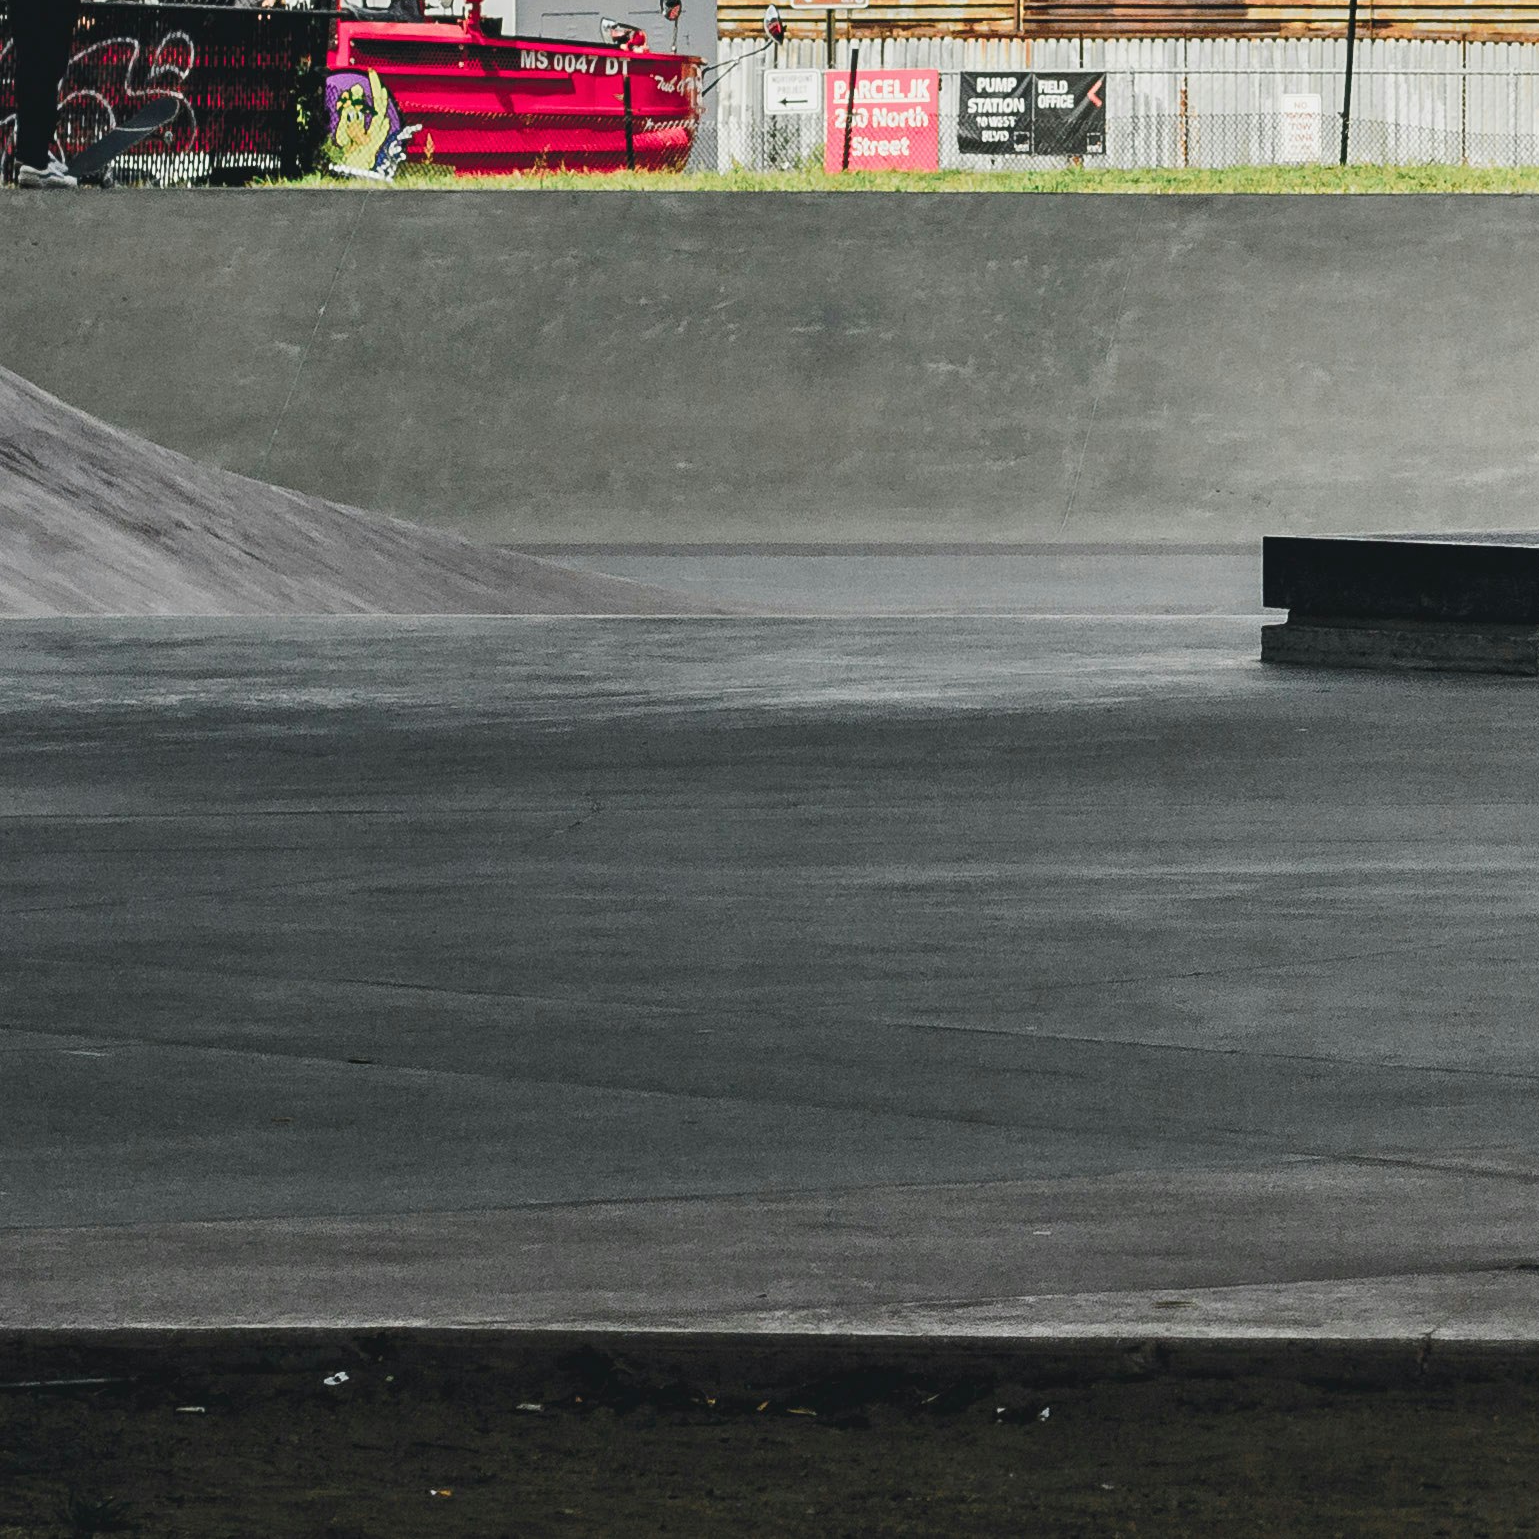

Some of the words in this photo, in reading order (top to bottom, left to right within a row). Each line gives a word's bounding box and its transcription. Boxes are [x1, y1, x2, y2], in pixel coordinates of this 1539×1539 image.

[520, 50, 548, 70] MS
[554, 54, 598, 75] 0047
[605, 57, 630, 76] DT
[834, 80, 904, 99] PARCEL
[908, 78, 930, 98] JK
[976, 77, 1017, 93] PUMP
[1038, 79, 1068, 94] FIELD
[967, 97, 1025, 114] STATION
[1038, 94, 1074, 109] OFFICE
[834, 108, 868, 128] 20
[872, 106, 929, 128] North
[989, 115, 1016, 128] WEST
[981, 130, 1009, 142] BLVD
[851, 136, 910, 157] Street
